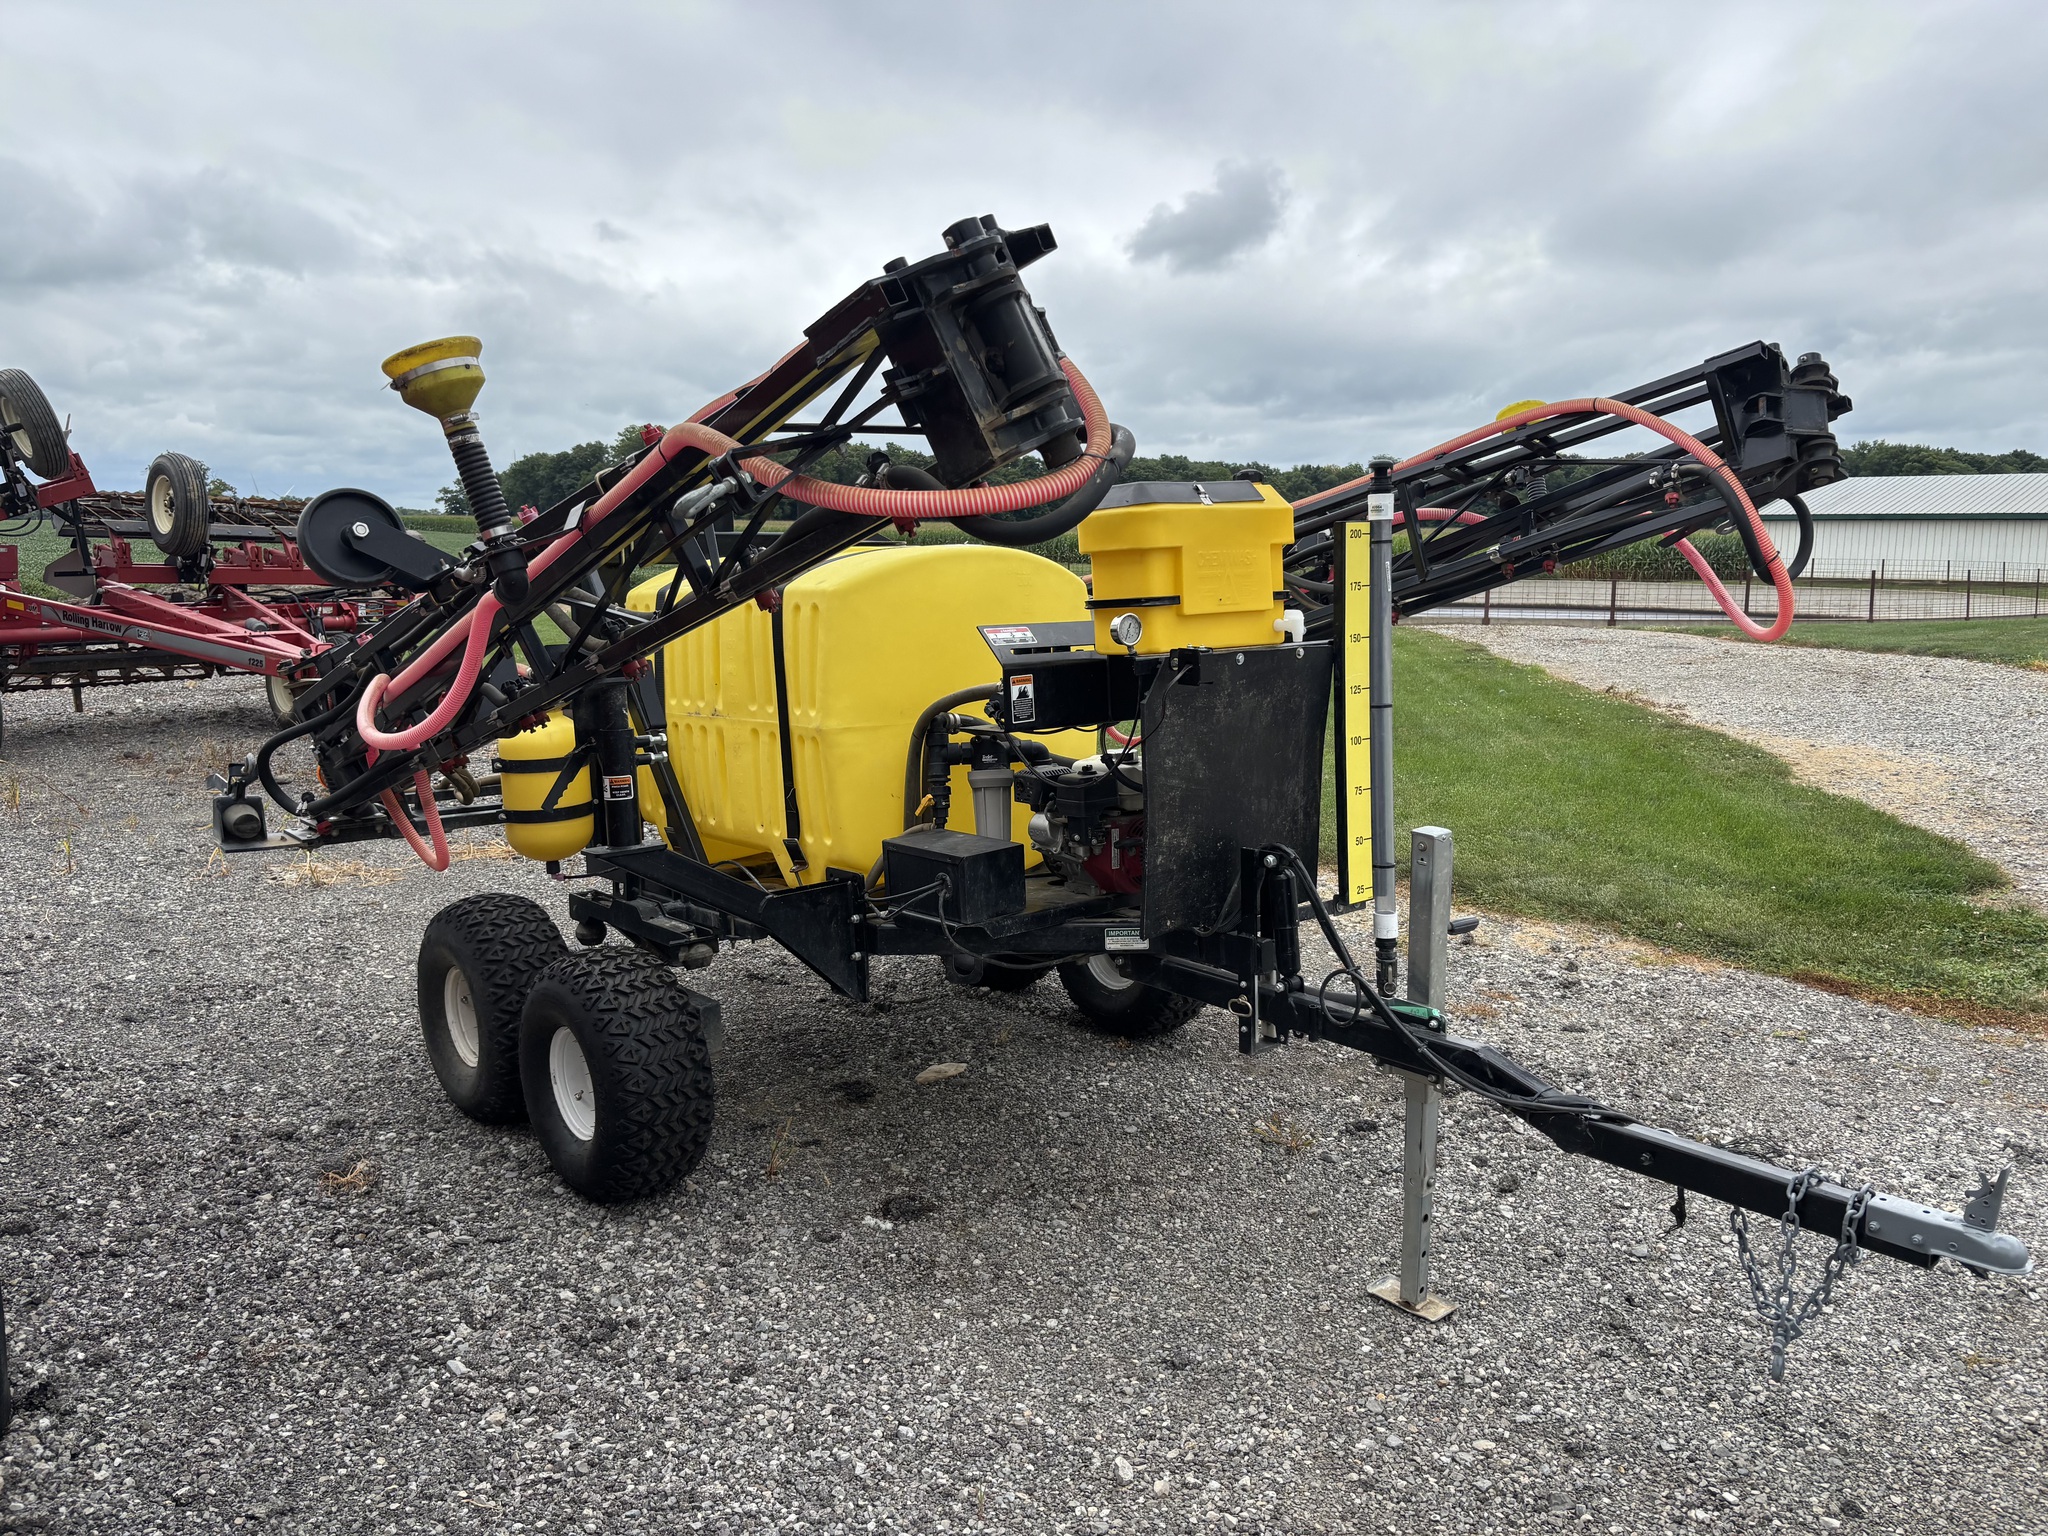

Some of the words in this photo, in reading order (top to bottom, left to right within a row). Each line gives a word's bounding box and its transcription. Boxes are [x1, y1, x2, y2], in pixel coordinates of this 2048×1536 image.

[1350, 529, 1362, 539] 200
[1350, 581, 1362, 591] 175
[62, 610, 90, 628] Rolling
[91, 616, 122, 633] Harrow
[1350, 633, 1362, 643] 150
[248, 657, 264, 668] 1225
[1350, 685, 1362, 694] 125
[1350, 736, 1362, 745] 100
[1354, 786, 1363, 796] 75
[1355, 836, 1364, 846] 50
[1356, 885, 1365, 895] 25
